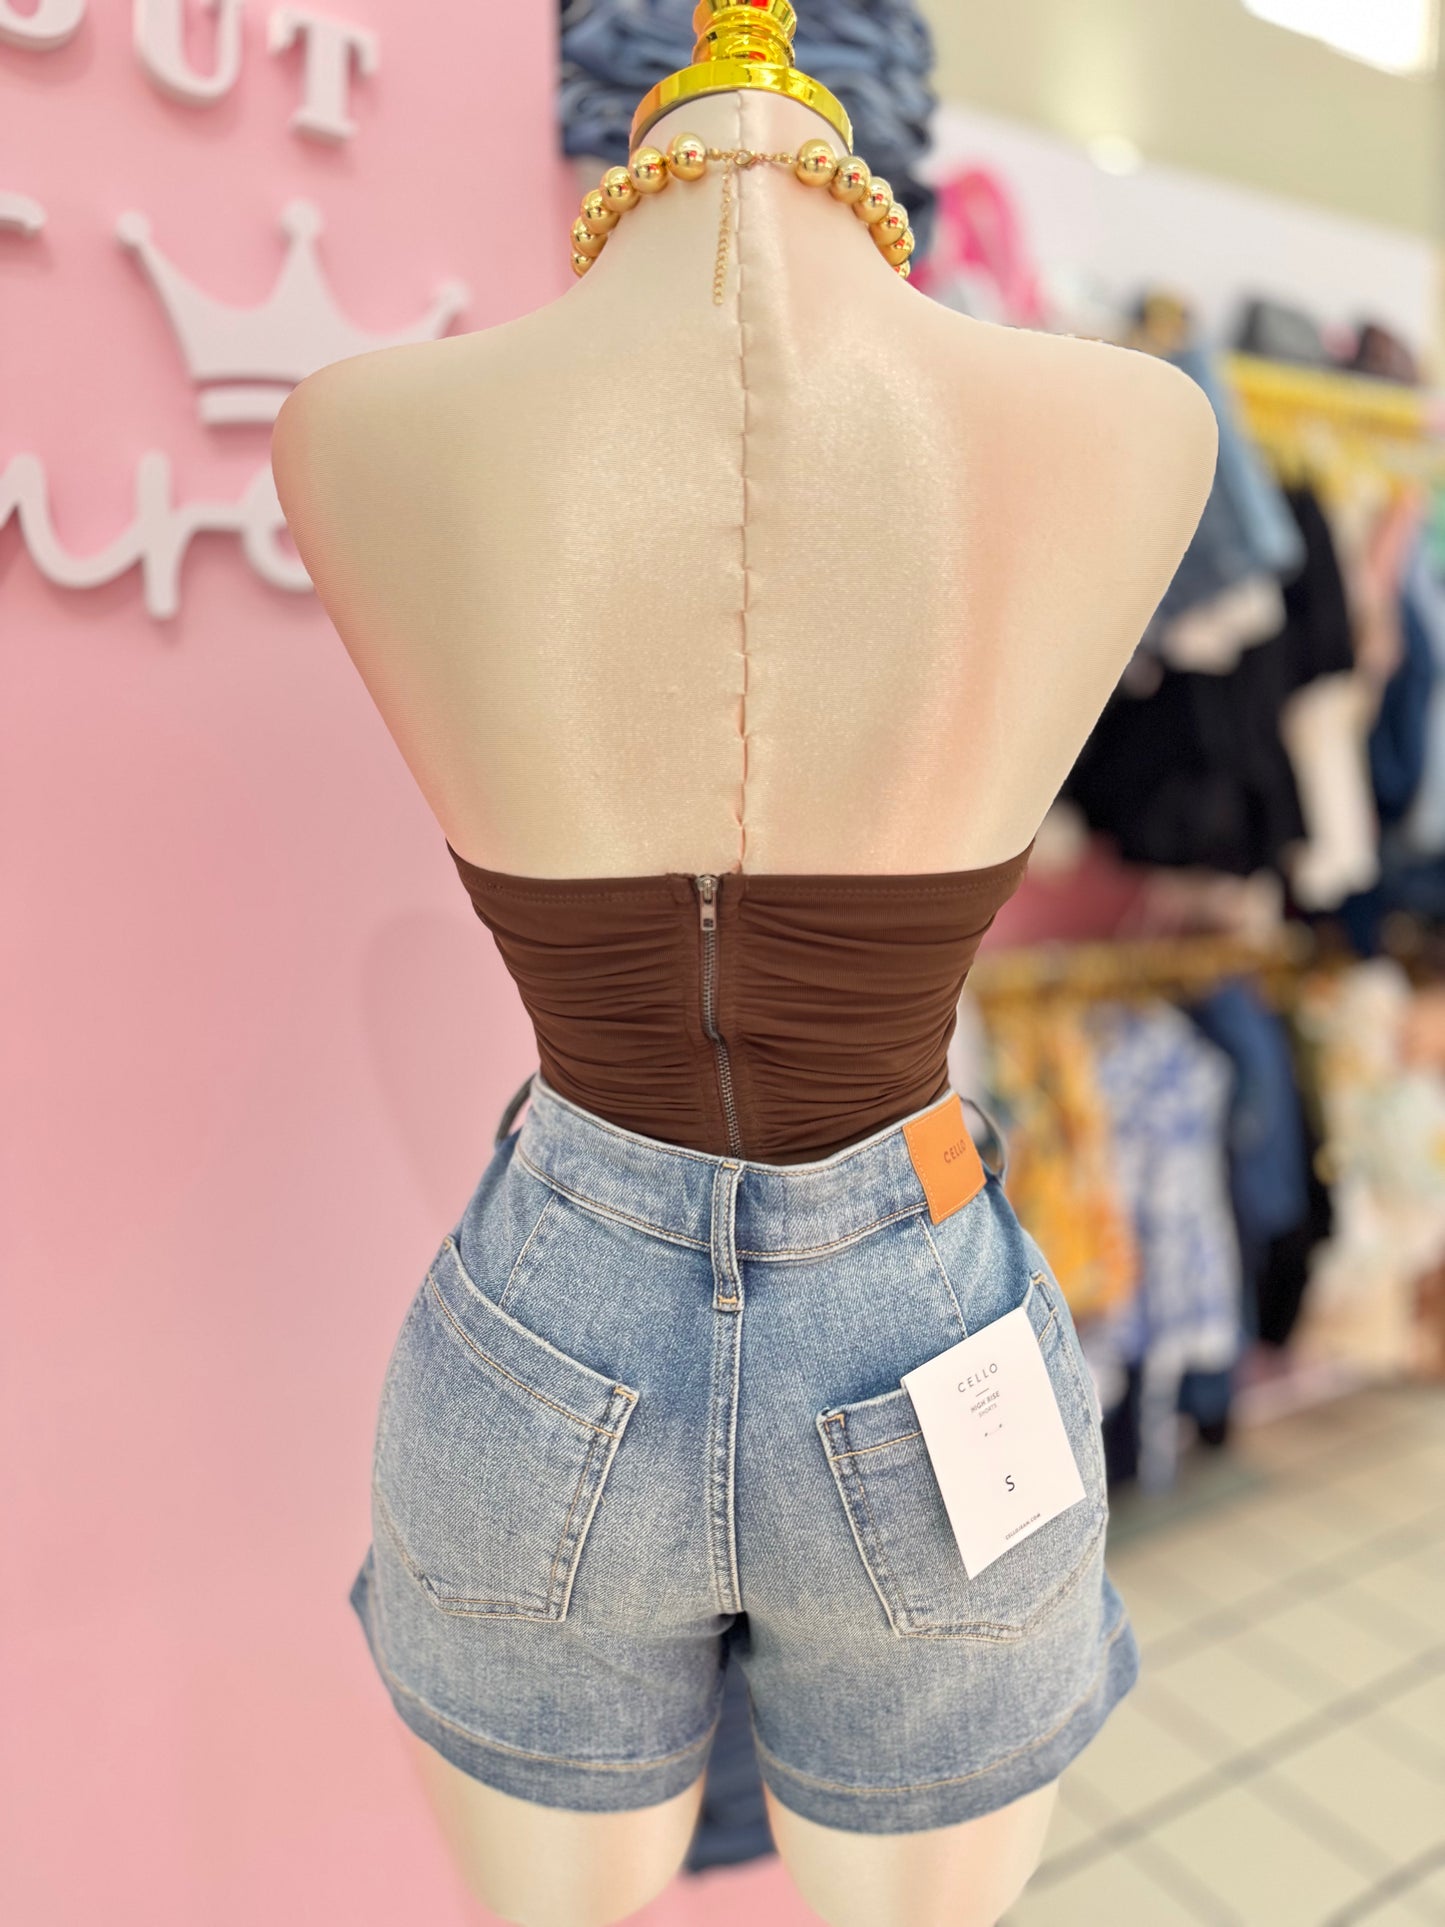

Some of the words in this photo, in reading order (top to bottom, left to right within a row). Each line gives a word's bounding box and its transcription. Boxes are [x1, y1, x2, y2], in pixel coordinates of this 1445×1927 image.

[943, 1139, 966, 1164] CELLO
[957, 1363, 998, 1393] CELLO
[986, 1391, 1000, 1403] RISE
[1005, 1474, 1016, 1492] S
